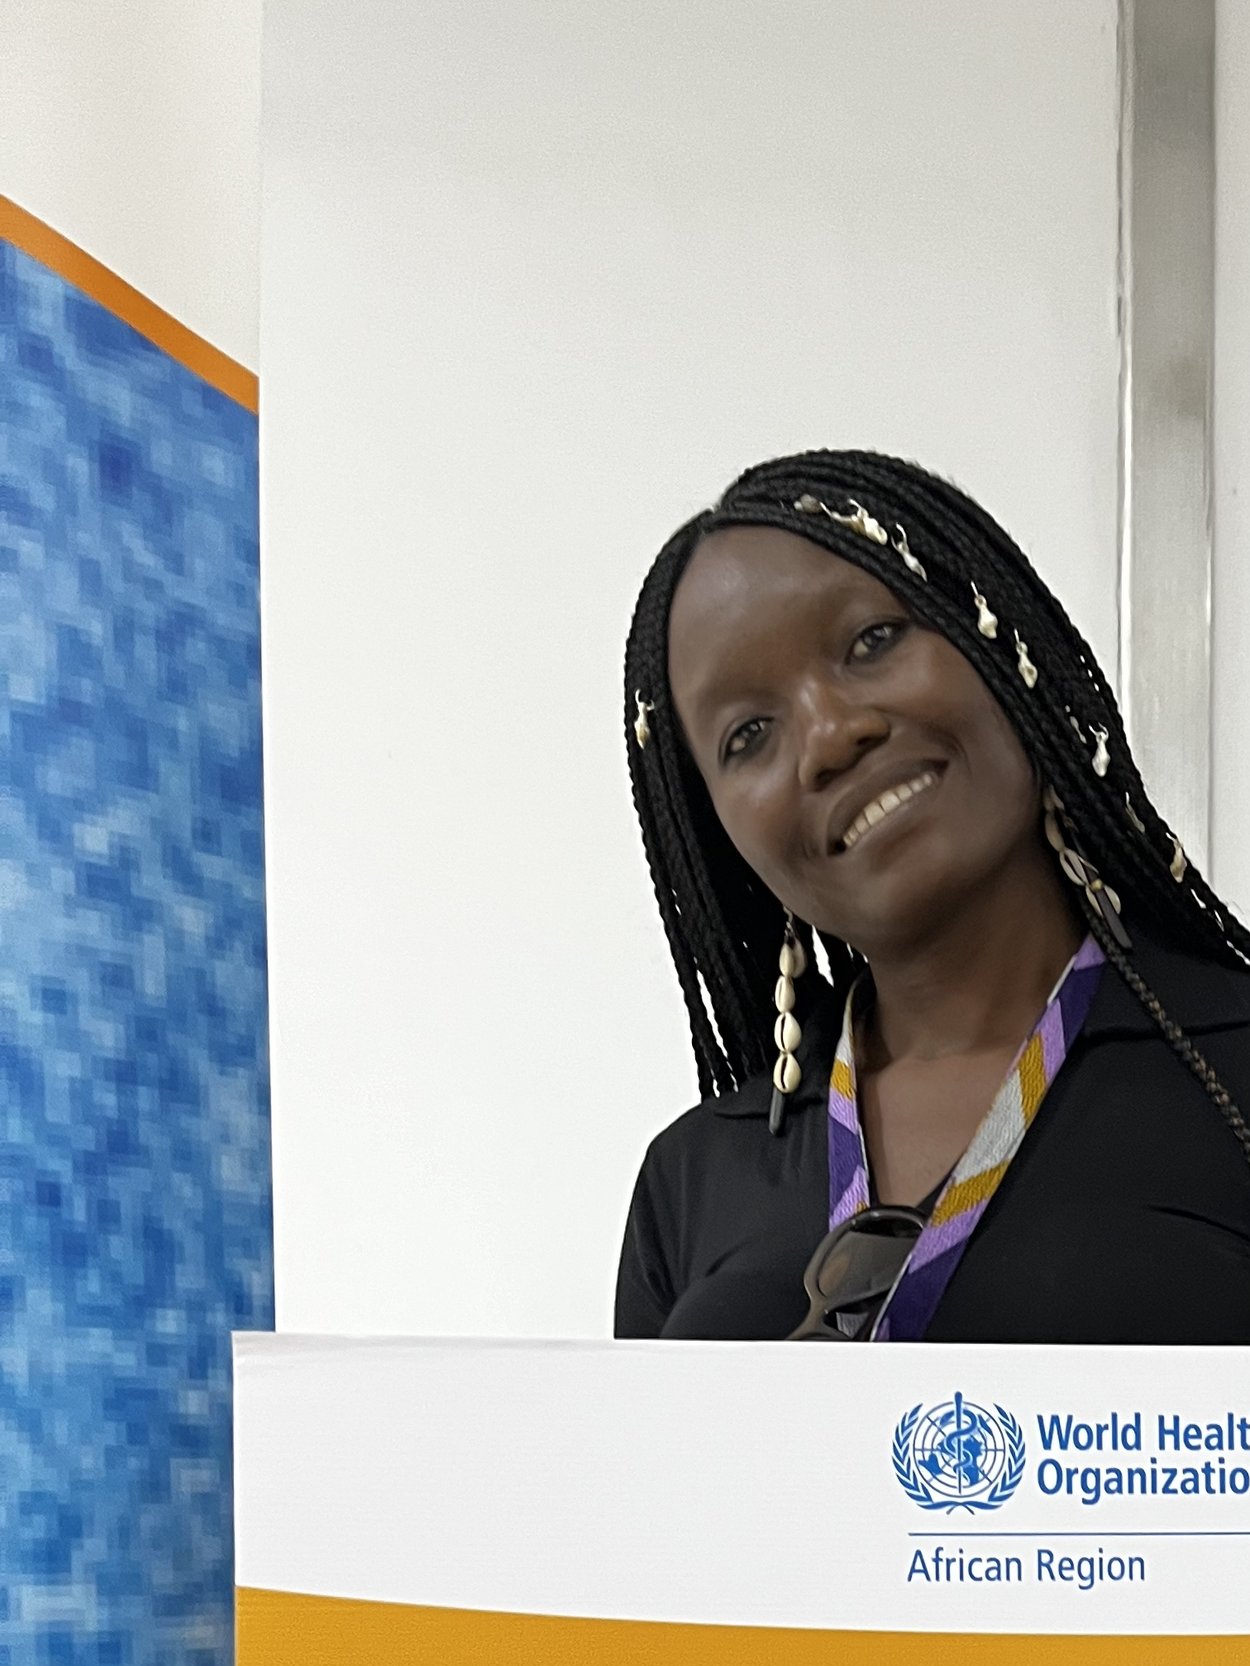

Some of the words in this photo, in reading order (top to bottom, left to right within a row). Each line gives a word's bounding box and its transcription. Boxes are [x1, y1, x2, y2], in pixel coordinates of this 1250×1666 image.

[1036, 1411, 1142, 1451] World
[907, 1546, 1022, 1583] African
[1037, 1547, 1145, 1591] Region
